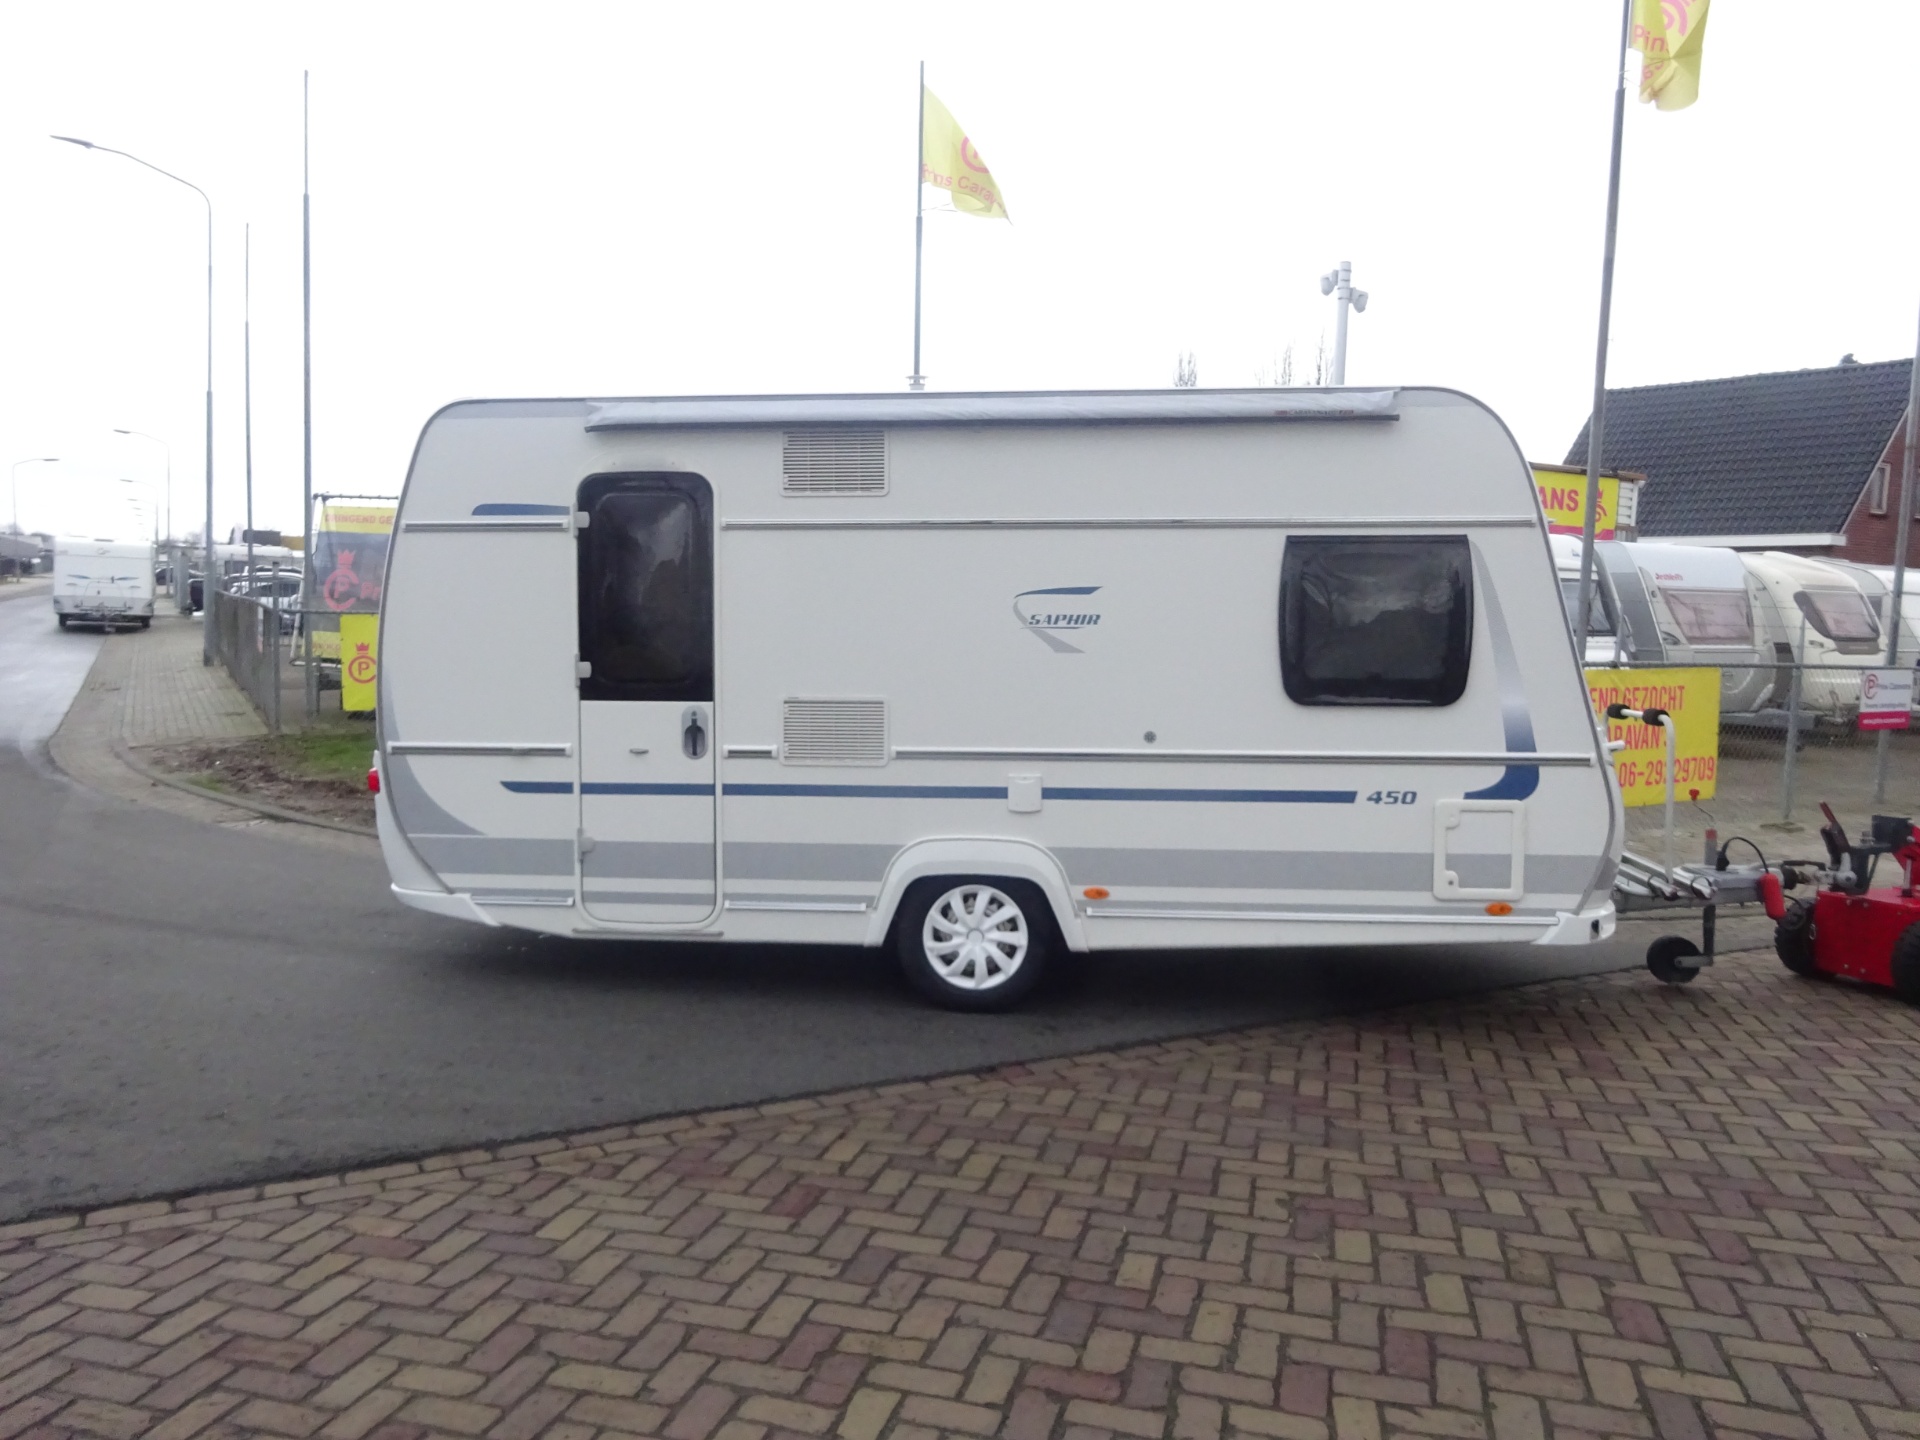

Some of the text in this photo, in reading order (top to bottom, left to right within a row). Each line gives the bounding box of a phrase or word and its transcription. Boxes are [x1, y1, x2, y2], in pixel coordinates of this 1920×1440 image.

[1029, 614, 1102, 626] SAPHIR
[1622, 685, 1684, 711] GEZOCHT
[1618, 756, 1715, 788] 06-2929709
[1366, 790, 1418, 805] 450
